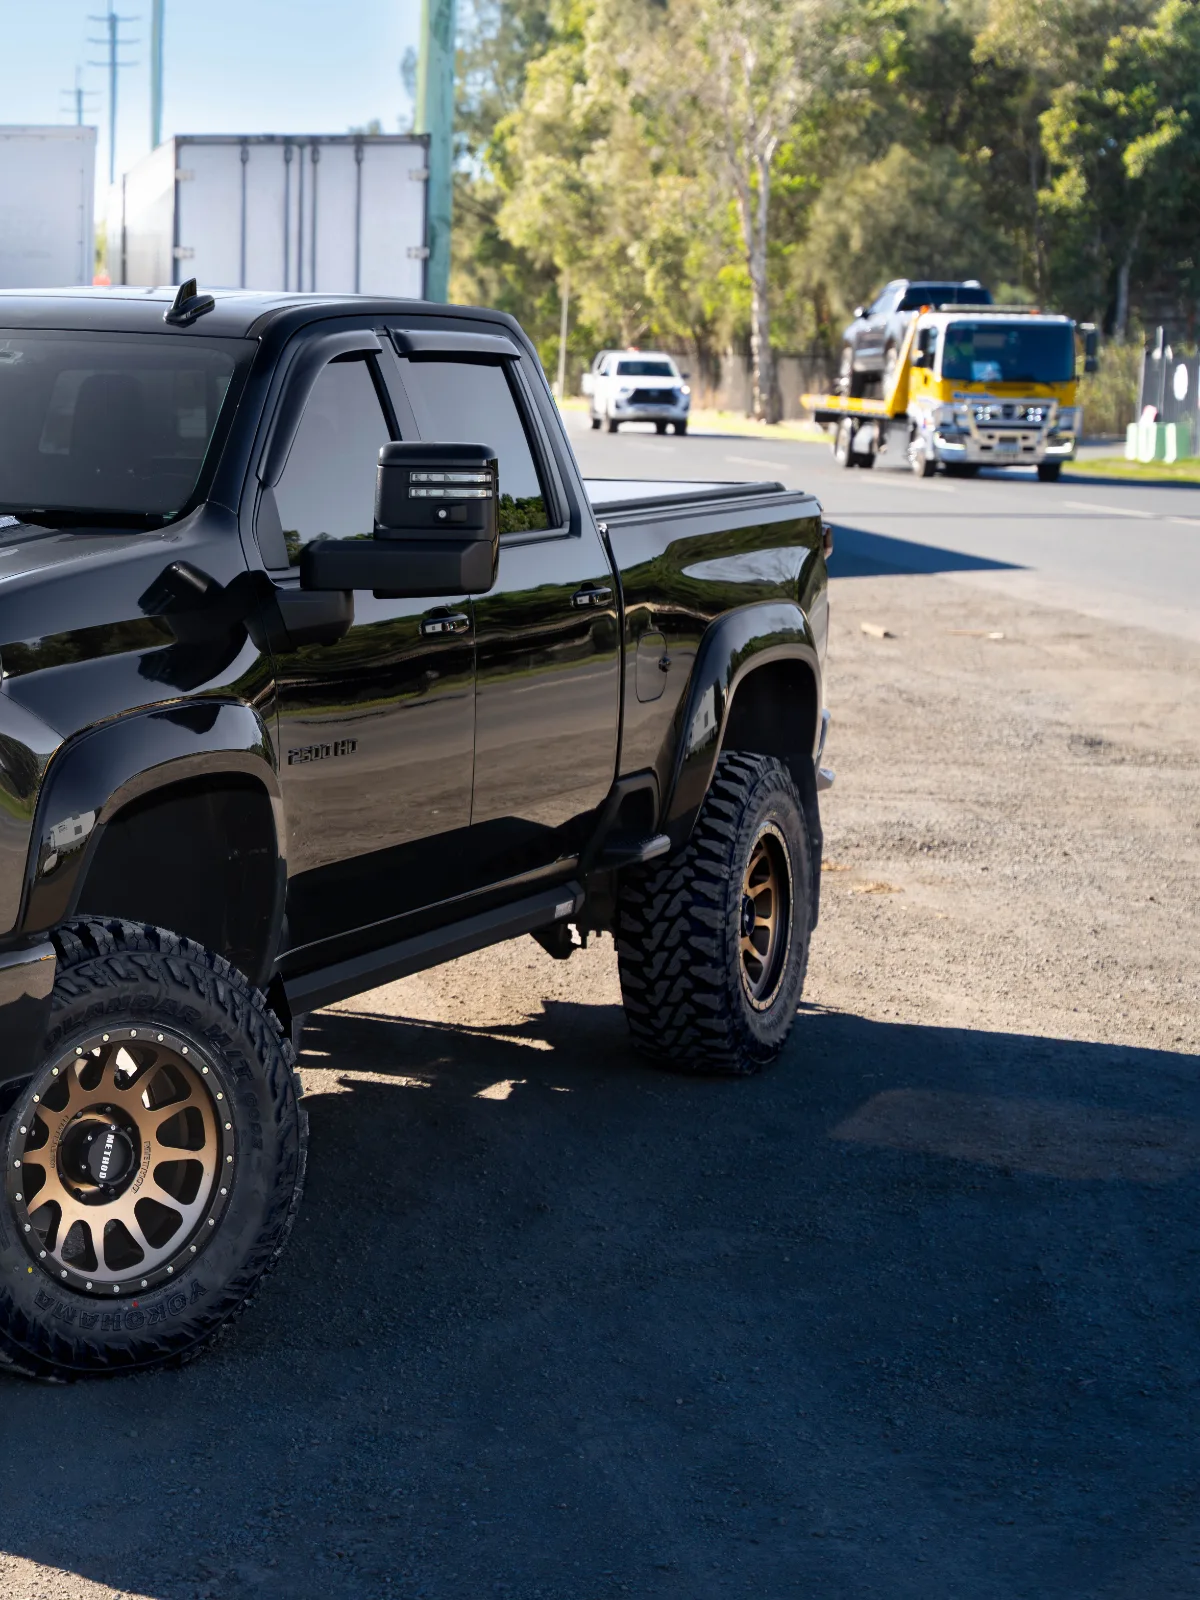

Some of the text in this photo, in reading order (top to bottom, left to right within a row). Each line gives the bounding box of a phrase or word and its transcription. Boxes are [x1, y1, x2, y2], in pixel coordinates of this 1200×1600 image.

[288, 742, 332, 765] 2500
[43, 995, 202, 1053] OLANDAR
[98, 1133, 115, 1179] METHOD
[33, 1278, 210, 1332] YOKOHAMA
